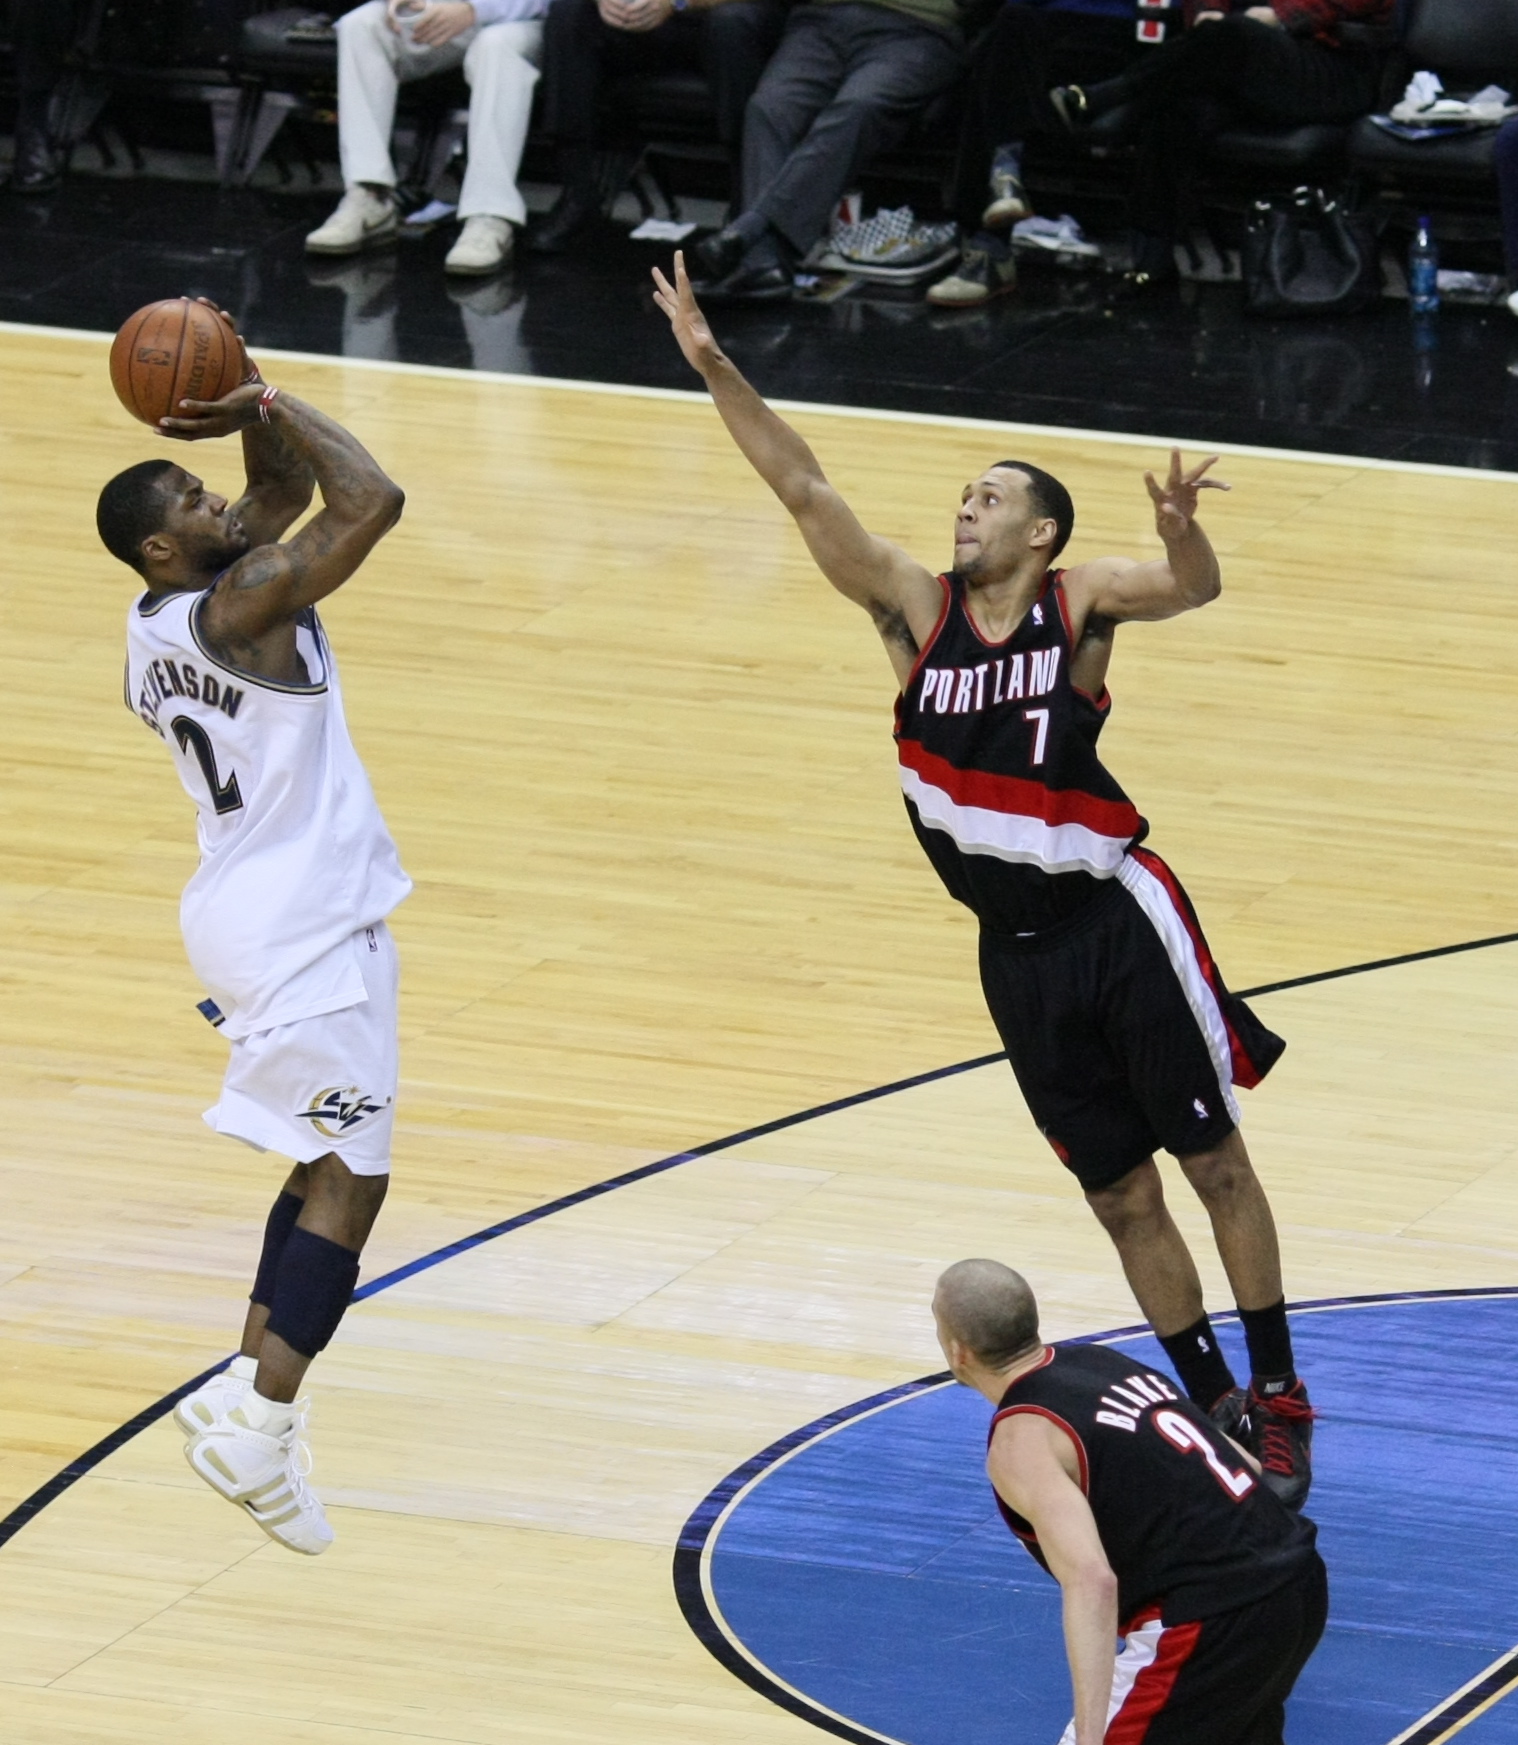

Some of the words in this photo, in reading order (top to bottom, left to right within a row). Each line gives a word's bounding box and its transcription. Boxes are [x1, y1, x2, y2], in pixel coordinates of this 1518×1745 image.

[185, 320, 210, 400] SPALDIN
[919, 646, 1061, 714] PORTLAND
[170, 715, 244, 815] 2
[1024, 708, 1049, 765] 7
[1095, 1374, 1178, 1433] BLAKE
[1264, 1381, 1286, 1394] NIKE
[1152, 1408, 1258, 1503] 2
